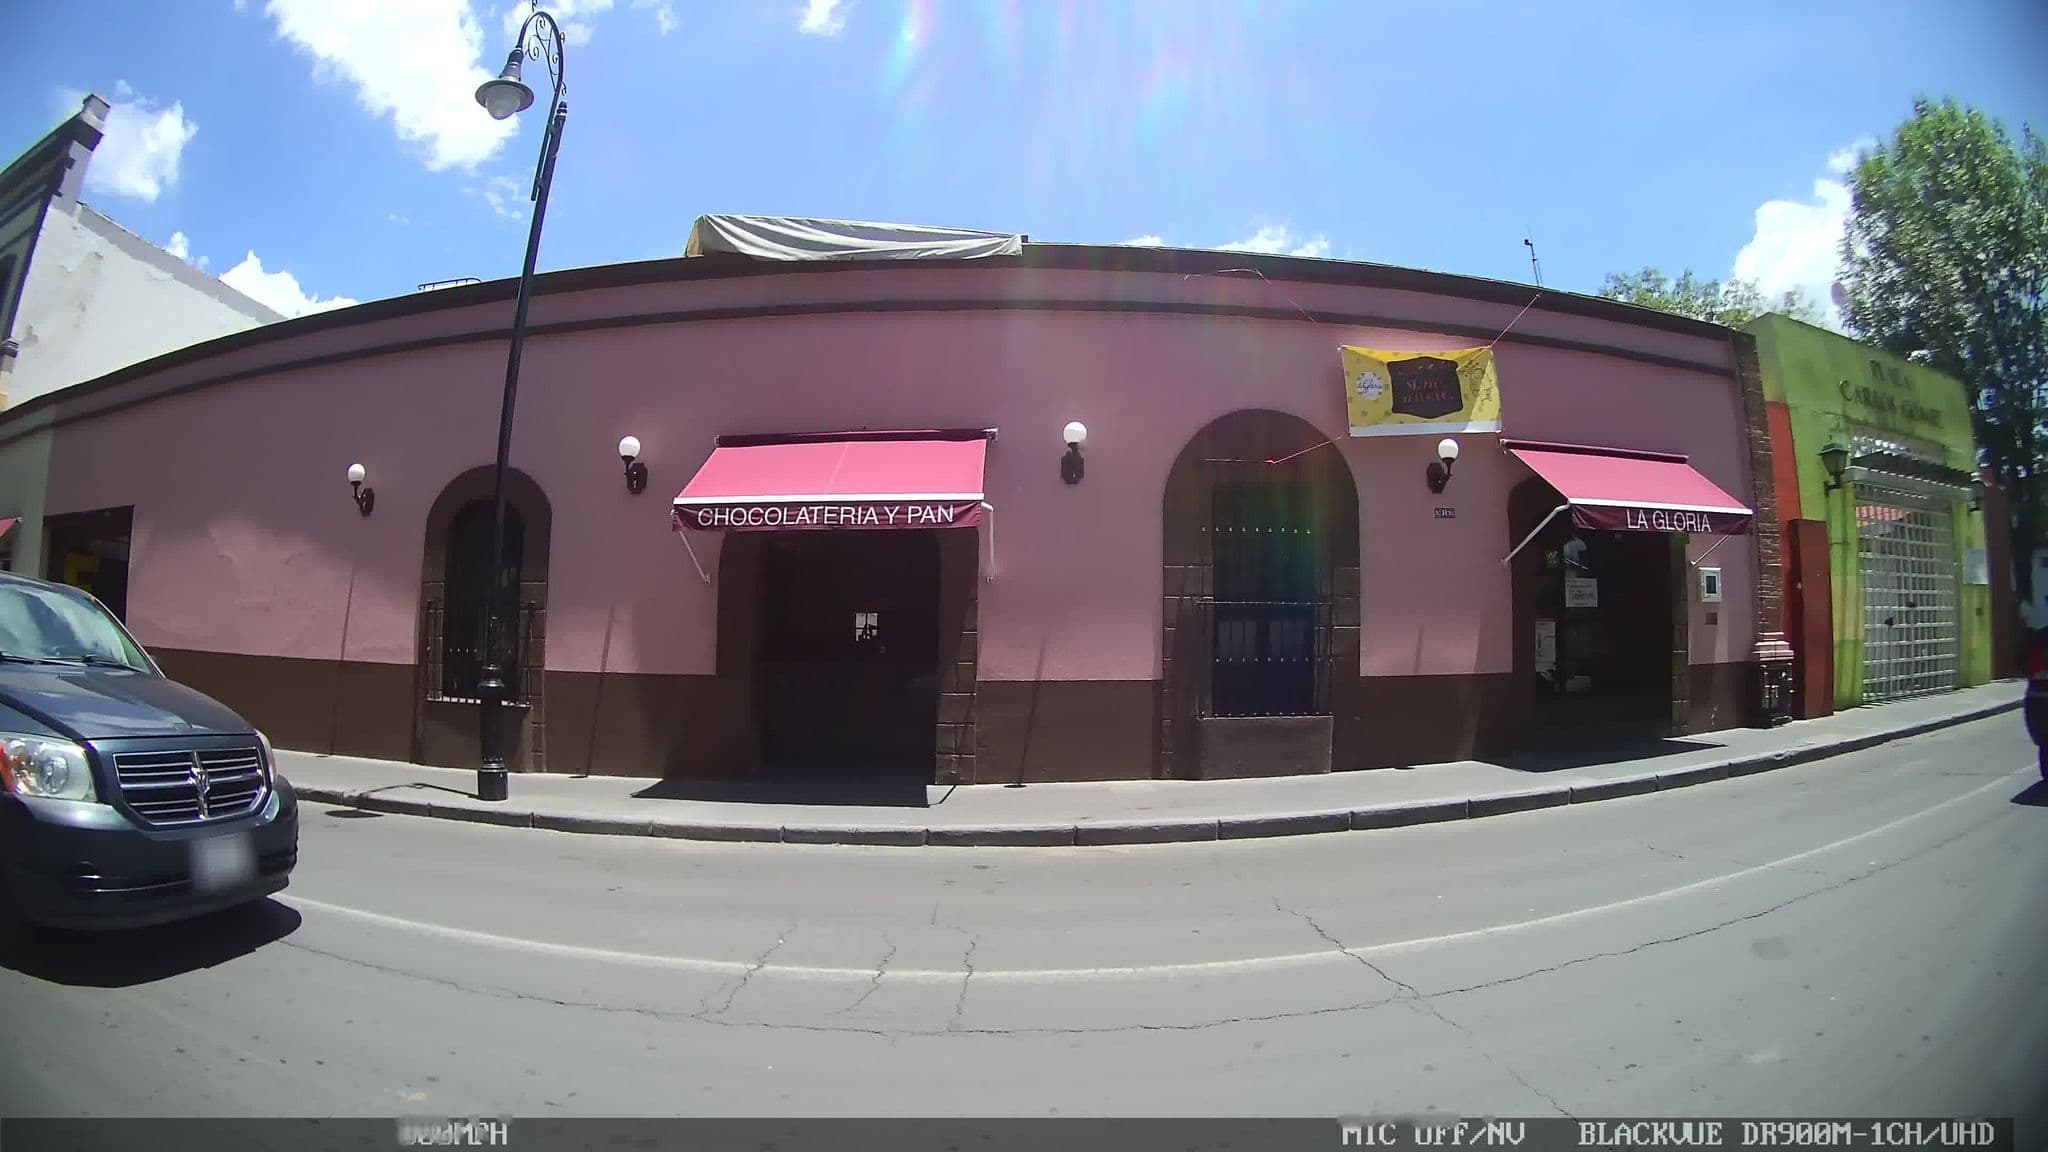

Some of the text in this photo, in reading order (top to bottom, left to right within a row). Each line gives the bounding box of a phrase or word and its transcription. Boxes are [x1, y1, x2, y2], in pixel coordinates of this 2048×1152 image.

[698, 504, 954, 526] CHOCOLATERIA Y PAN
[1626, 508, 1712, 533] LA GLORIA
